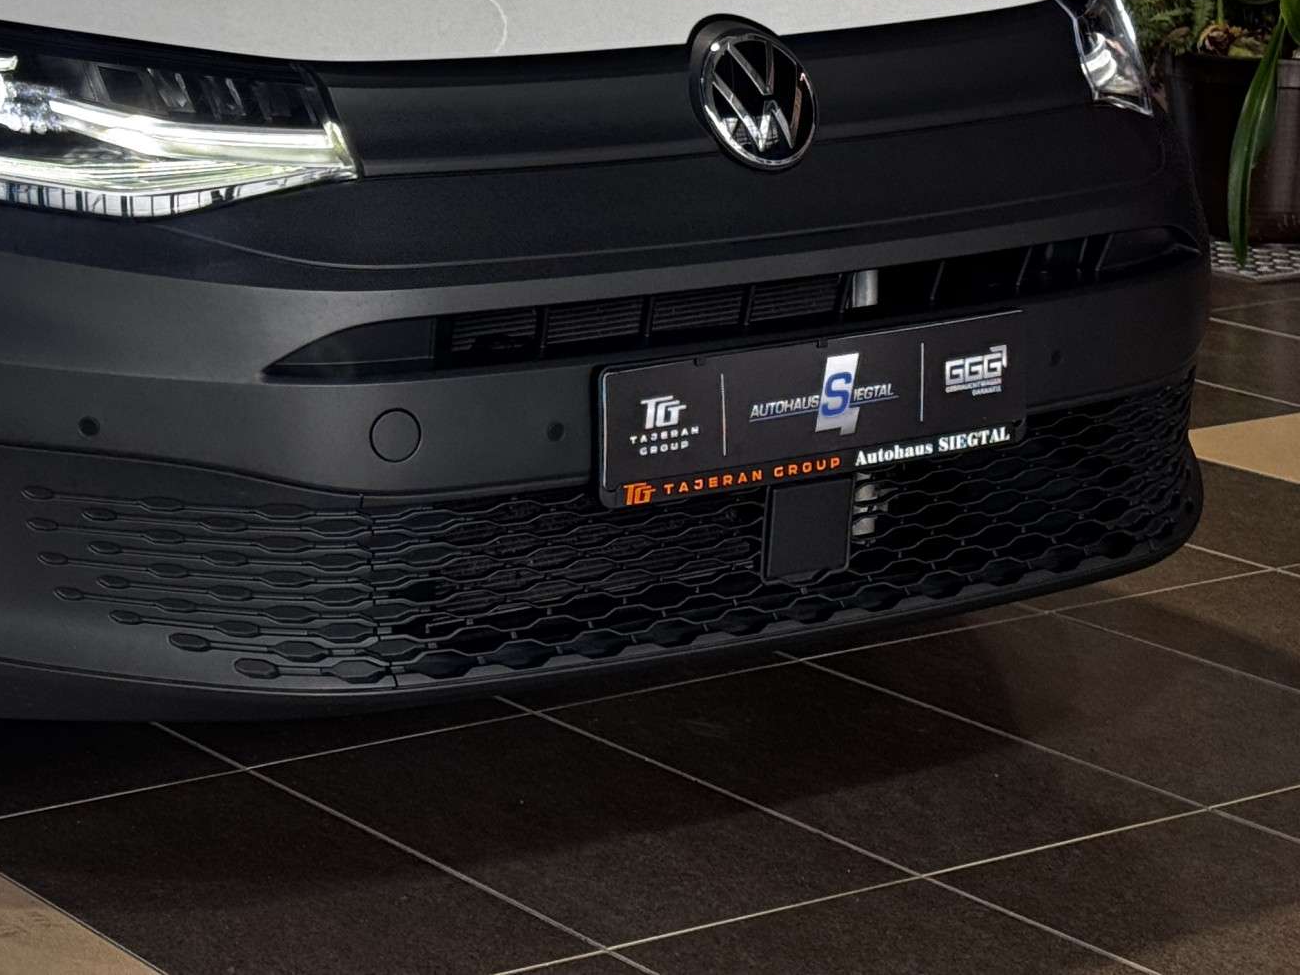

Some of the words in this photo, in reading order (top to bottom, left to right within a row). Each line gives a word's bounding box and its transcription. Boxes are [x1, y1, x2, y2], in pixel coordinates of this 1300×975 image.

[750, 395, 820, 418] AUTOHAUS
[630, 426, 699, 444] TAJERAN
[639, 440, 689, 456] GROUP
[855, 443, 933, 467] Autohaus
[938, 427, 1010, 452] SIEGTAL
[663, 469, 763, 495] TAJERAN
[773, 457, 842, 479] GROUP
